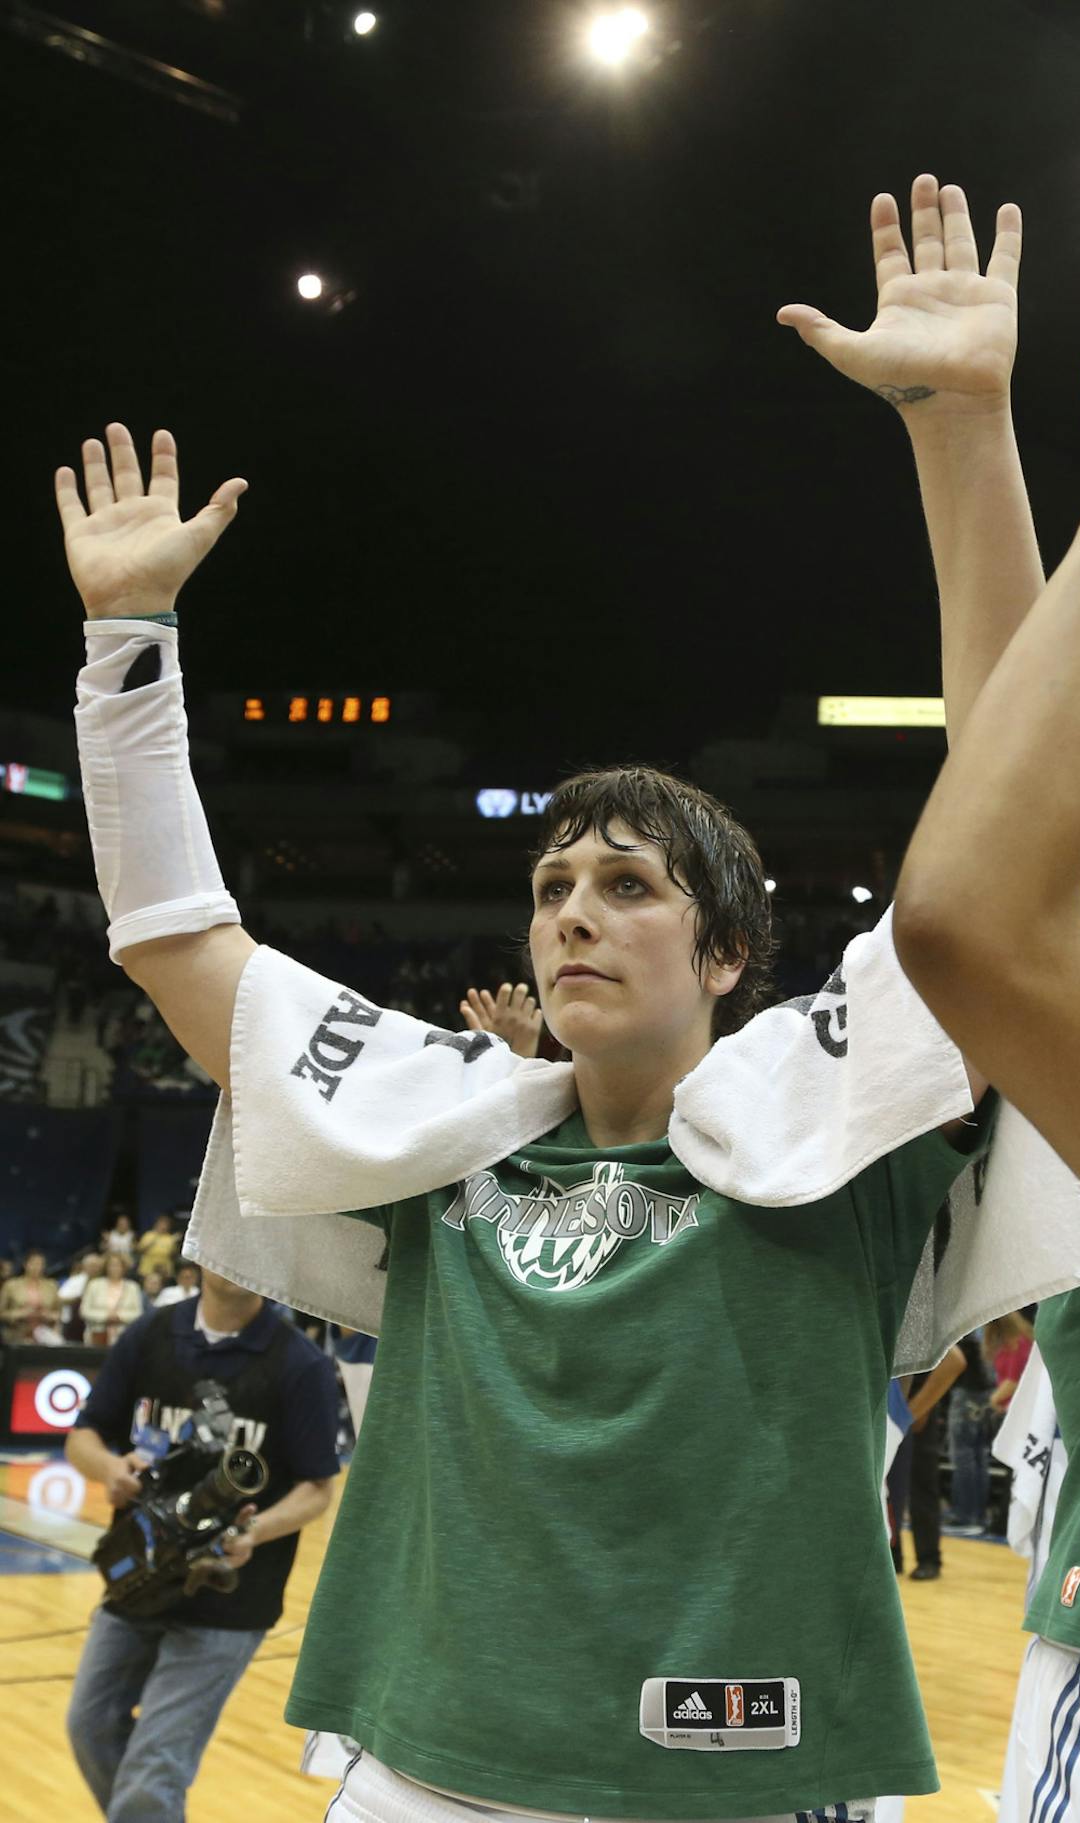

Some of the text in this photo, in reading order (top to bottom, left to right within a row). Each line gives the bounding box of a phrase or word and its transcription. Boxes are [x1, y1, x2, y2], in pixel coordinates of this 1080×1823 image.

[290, 989, 383, 1103] ADE
[673, 1709, 713, 1720] adidas
[750, 1700, 779, 1715] 2XL
